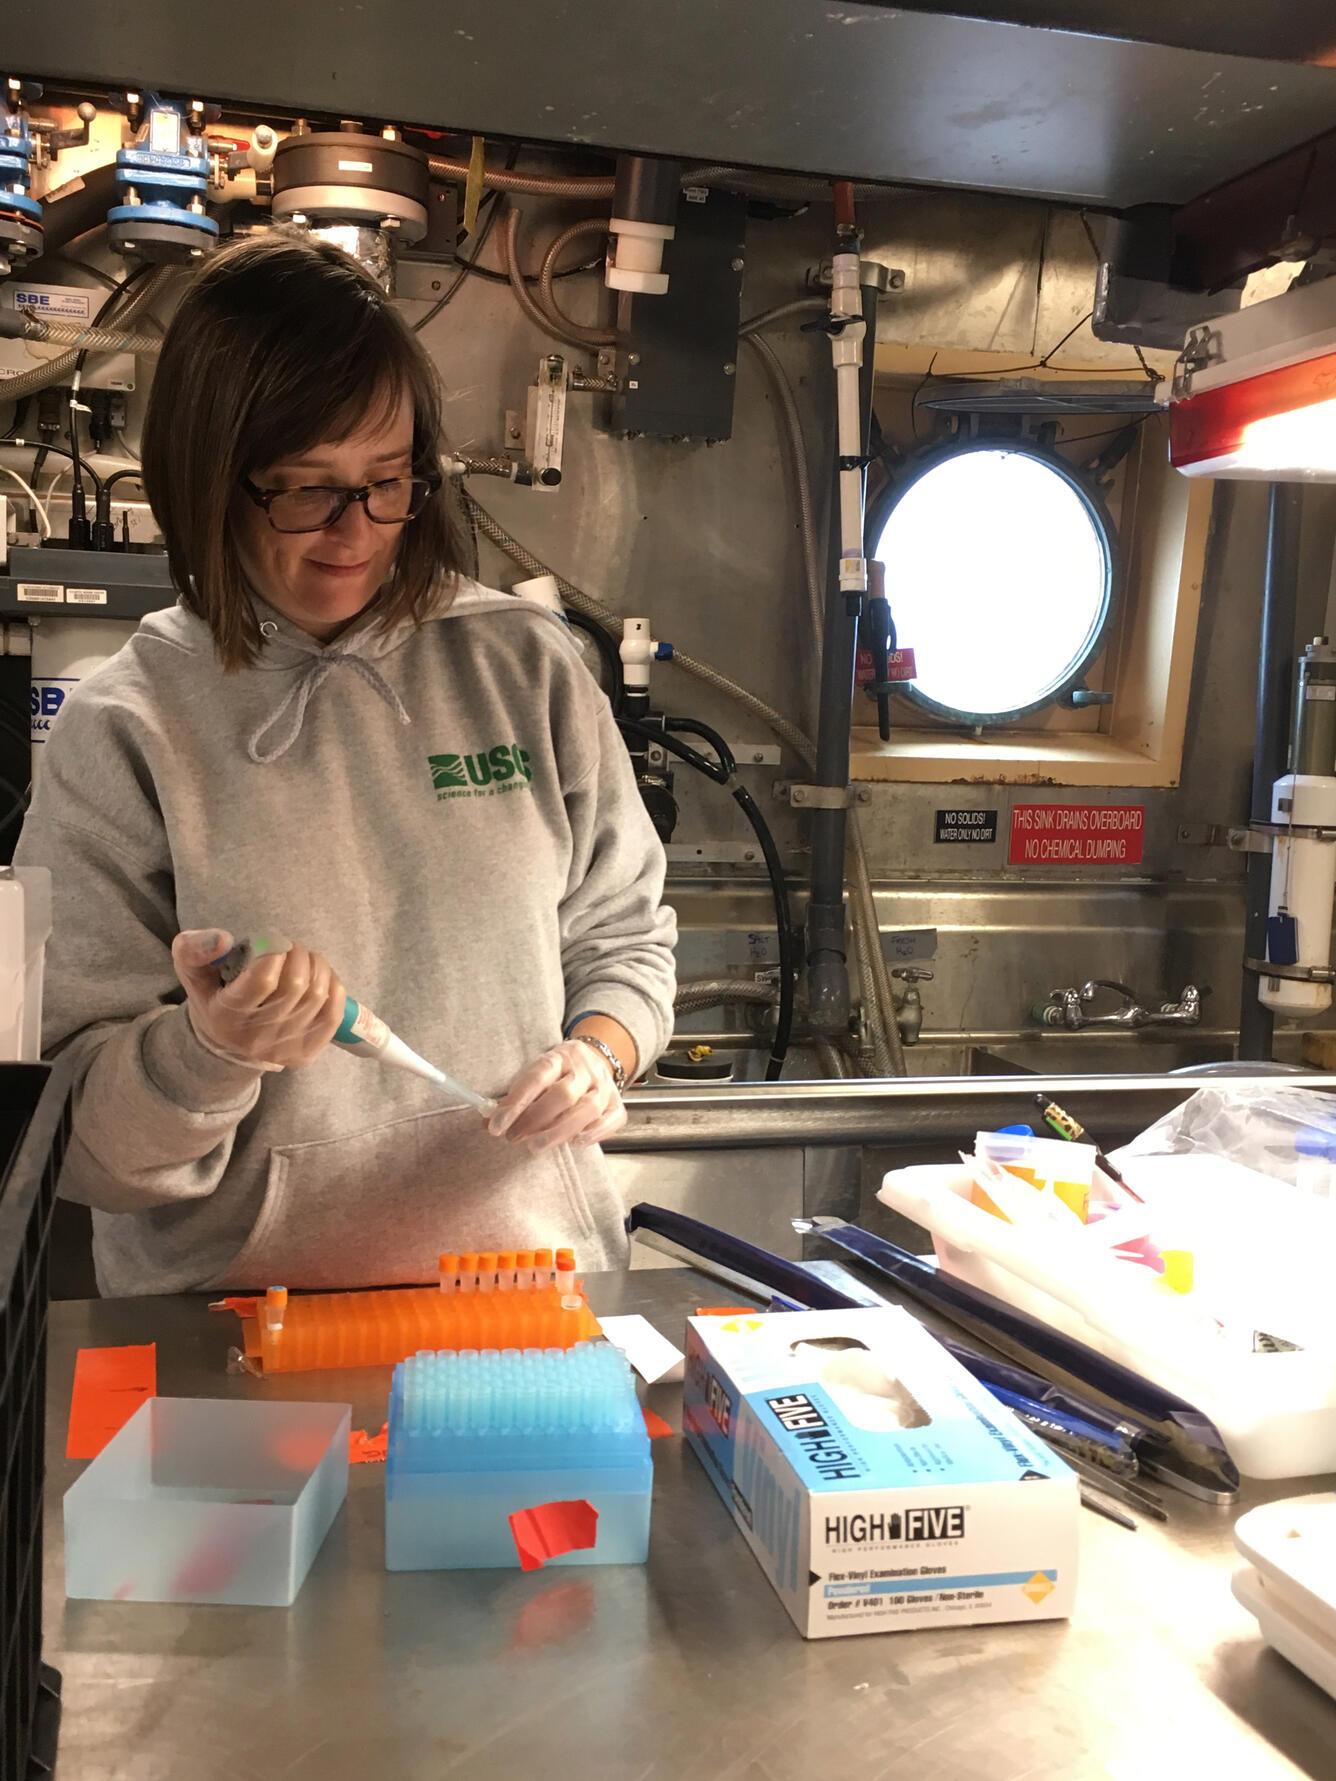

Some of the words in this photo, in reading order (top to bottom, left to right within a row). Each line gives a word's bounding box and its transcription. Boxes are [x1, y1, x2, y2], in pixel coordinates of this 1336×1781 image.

[16, 293, 50, 306] SBE
[437, 790, 471, 801] science
[474, 789, 486, 798] for
[945, 813, 957, 824] NO
[958, 813, 986, 825] SOLIDS!
[1013, 810, 1033, 830] THIS
[1034, 810, 1056, 830] SINK
[1056, 810, 1089, 830] DRAINS
[1090, 811, 1142, 830] OVERBOARD
[940, 828, 958, 840] WATER
[958, 828, 972, 840] ONLY
[971, 828, 981, 840] NO
[980, 828, 993, 840] DIRT
[1025, 839, 1040, 859] NO
[1040, 839, 1084, 858] CHEMICAL
[1086, 839, 1126, 858] DUMPING
[767, 1393, 826, 1431] FIVE
[800, 1439, 861, 1481] HIGH
[825, 1513, 885, 1544] HIGH
[907, 1507, 963, 1541] FIVE
[828, 1571, 868, 1582] Flex-Vinyl
[870, 1567, 918, 1579] Examination
[920, 1565, 947, 1575] Gloves
[827, 1599, 853, 1610] Order
[889, 1595, 905, 1605] 100
[906, 1594, 934, 1604] Gloves
